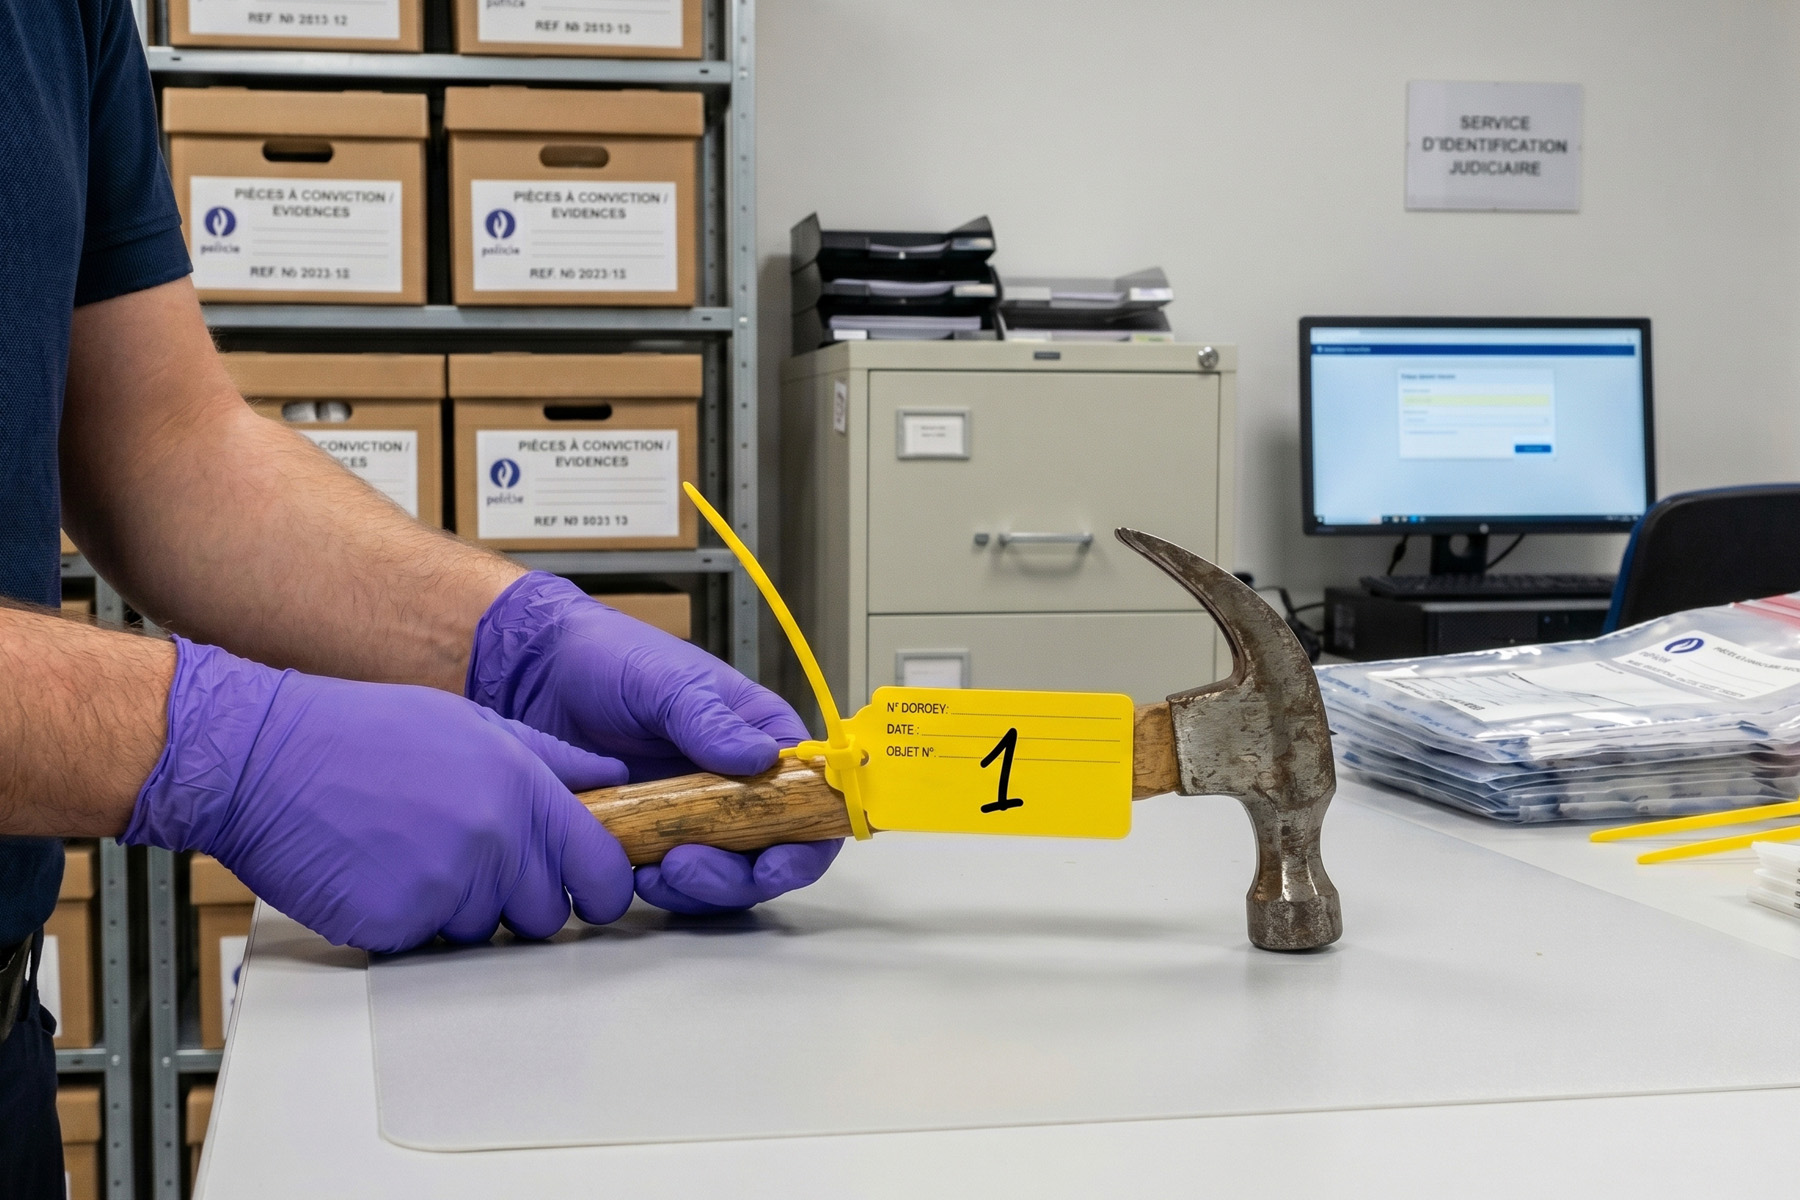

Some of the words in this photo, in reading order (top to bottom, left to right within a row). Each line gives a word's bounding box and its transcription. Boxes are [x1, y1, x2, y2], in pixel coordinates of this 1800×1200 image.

[1460, 115, 1530, 131] SERVICE
[1422, 136, 1568, 153] D'IDENTIFICATION
[1449, 160, 1541, 176] JUDICIAIRE
[301, 189, 386, 203] CONVICTION
[578, 191, 661, 204] CONVICTION
[273, 206, 350, 218] EVIDENCES
[552, 208, 627, 219] EVIDENCES
[582, 440, 664, 451] CONVICTION
[555, 456, 629, 467] EVIDENCES
[887, 723, 914, 735] DATE
[886, 745, 919, 757] OBJET
[980, 727, 1024, 813] 1
